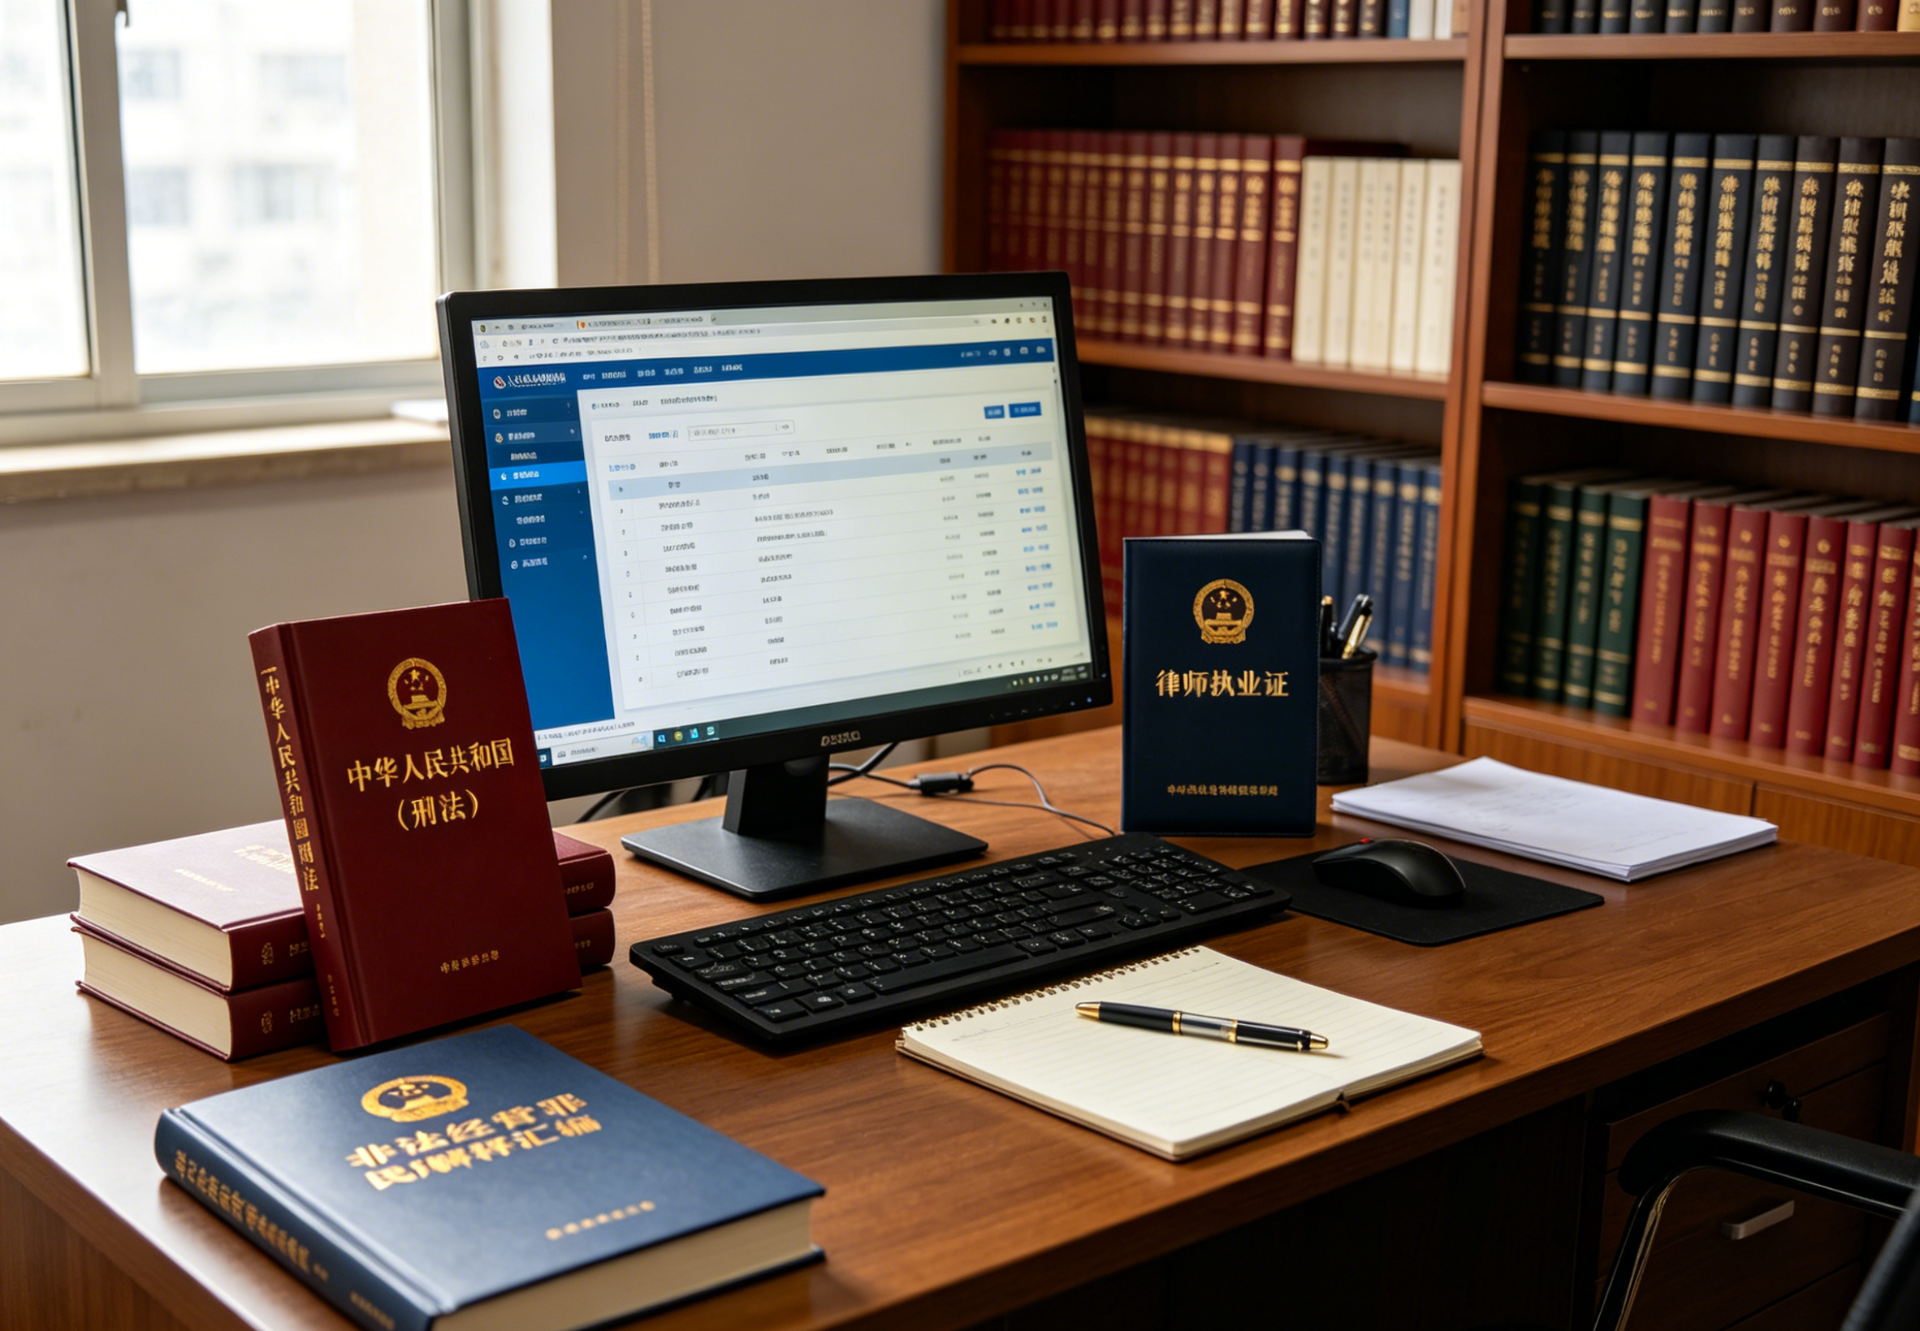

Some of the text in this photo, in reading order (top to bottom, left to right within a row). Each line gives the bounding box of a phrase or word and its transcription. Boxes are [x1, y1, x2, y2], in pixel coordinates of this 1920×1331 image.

[1156, 669, 1289, 698] 律师执业证
[347, 737, 515, 792] 中华人民共和国
